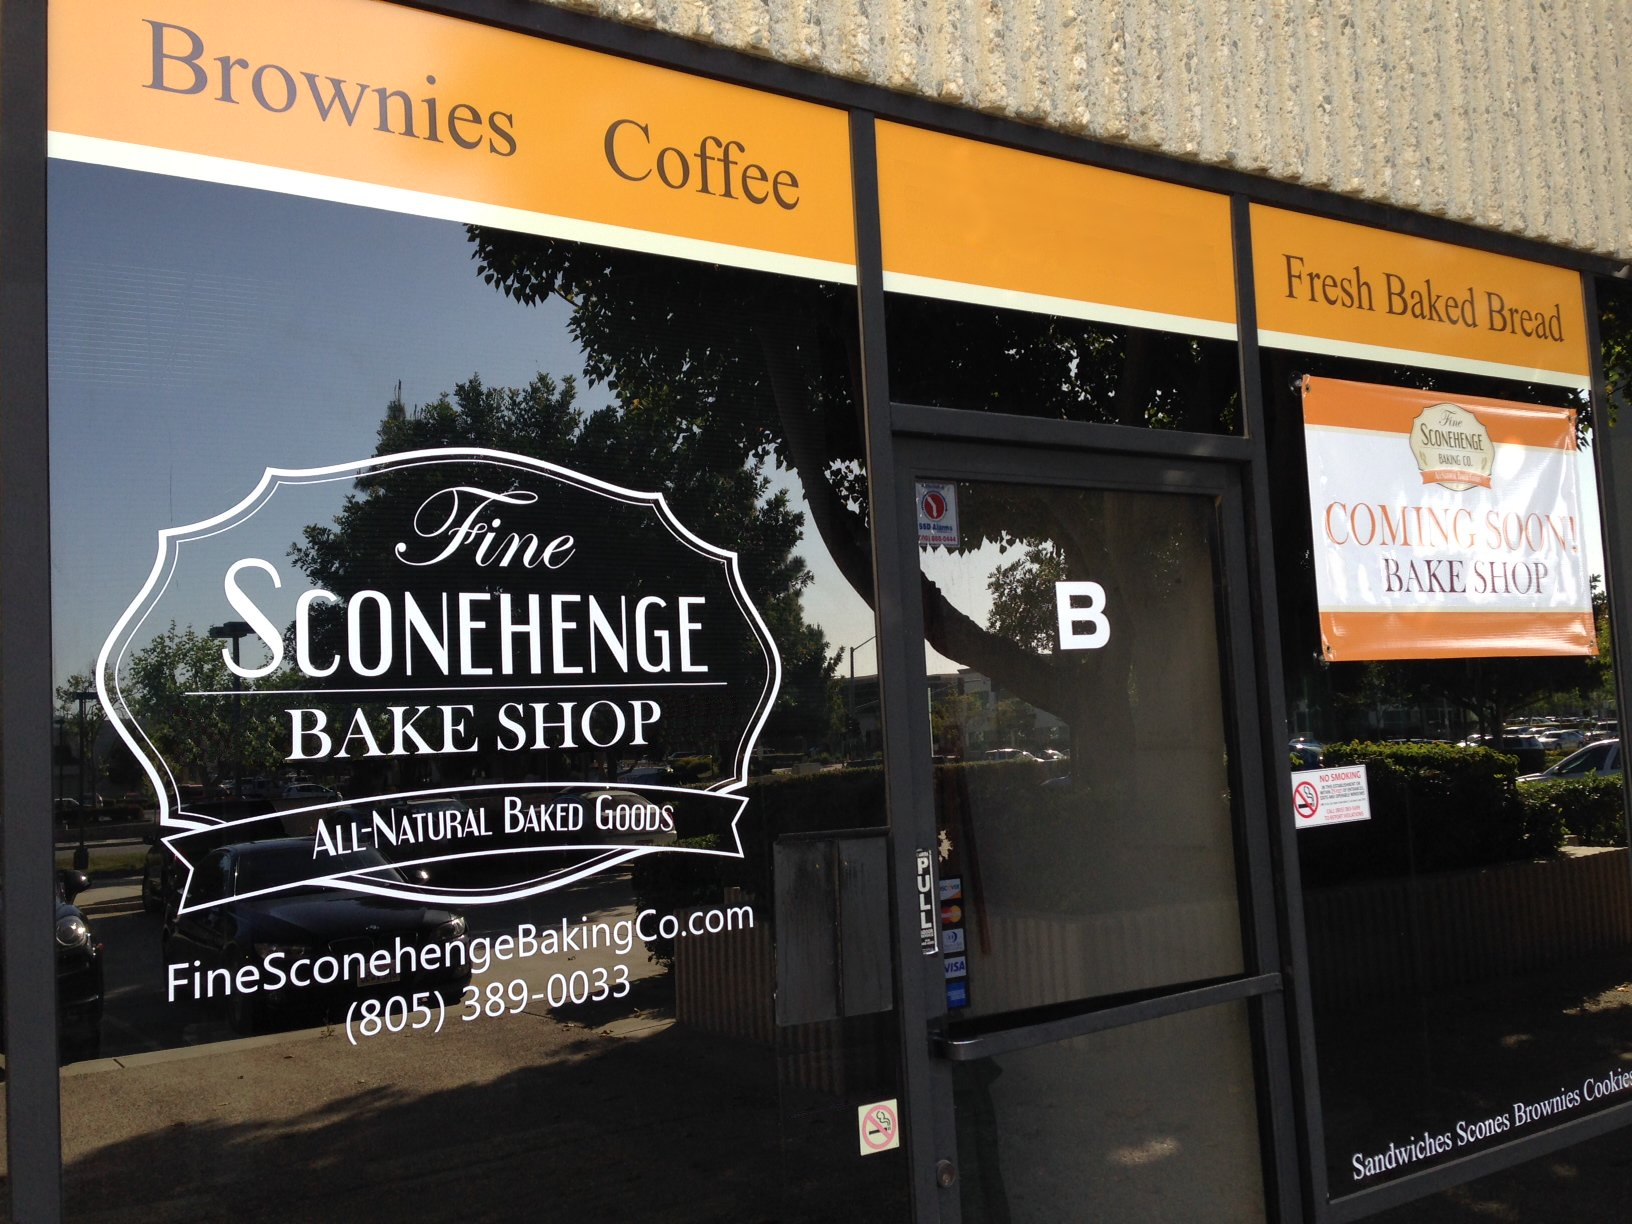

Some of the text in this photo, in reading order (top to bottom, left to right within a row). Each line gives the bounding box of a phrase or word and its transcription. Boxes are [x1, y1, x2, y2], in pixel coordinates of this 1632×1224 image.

[142, 18, 518, 158] Brownies
[604, 118, 801, 211] Coffee
[1281, 253, 1566, 343] Fresh Baked Bread
[1420, 422, 1484, 451] SCONEHENGE
[1439, 409, 1463, 427] Fine
[1438, 453, 1461, 466] BAKING
[395, 486, 576, 570] Fine
[1324, 501, 1578, 554] COMING SOON!
[1383, 558, 1549, 595] BAKE SHOP
[221, 557, 709, 679] SCONEHENGE
[1055, 580, 1111, 650] B
[285, 700, 662, 761] BAKE SHOP
[1319, 771, 1361, 782] NO SMOKING
[312, 794, 675, 860] ALL-NATURAL BAKED GOODS
[917, 857, 933, 929] PULL
[167, 905, 755, 1002] FineSconehengeBakingCo.com
[944, 961, 965, 973] VISA
[345, 988, 446, 1046] (805)
[460, 963, 632, 1023] 389-0033
[1352, 1131, 1452, 1181] Sandwiches
[1456, 1112, 1511, 1147] Scones
[1513, 1087, 1581, 1127] Brownies
